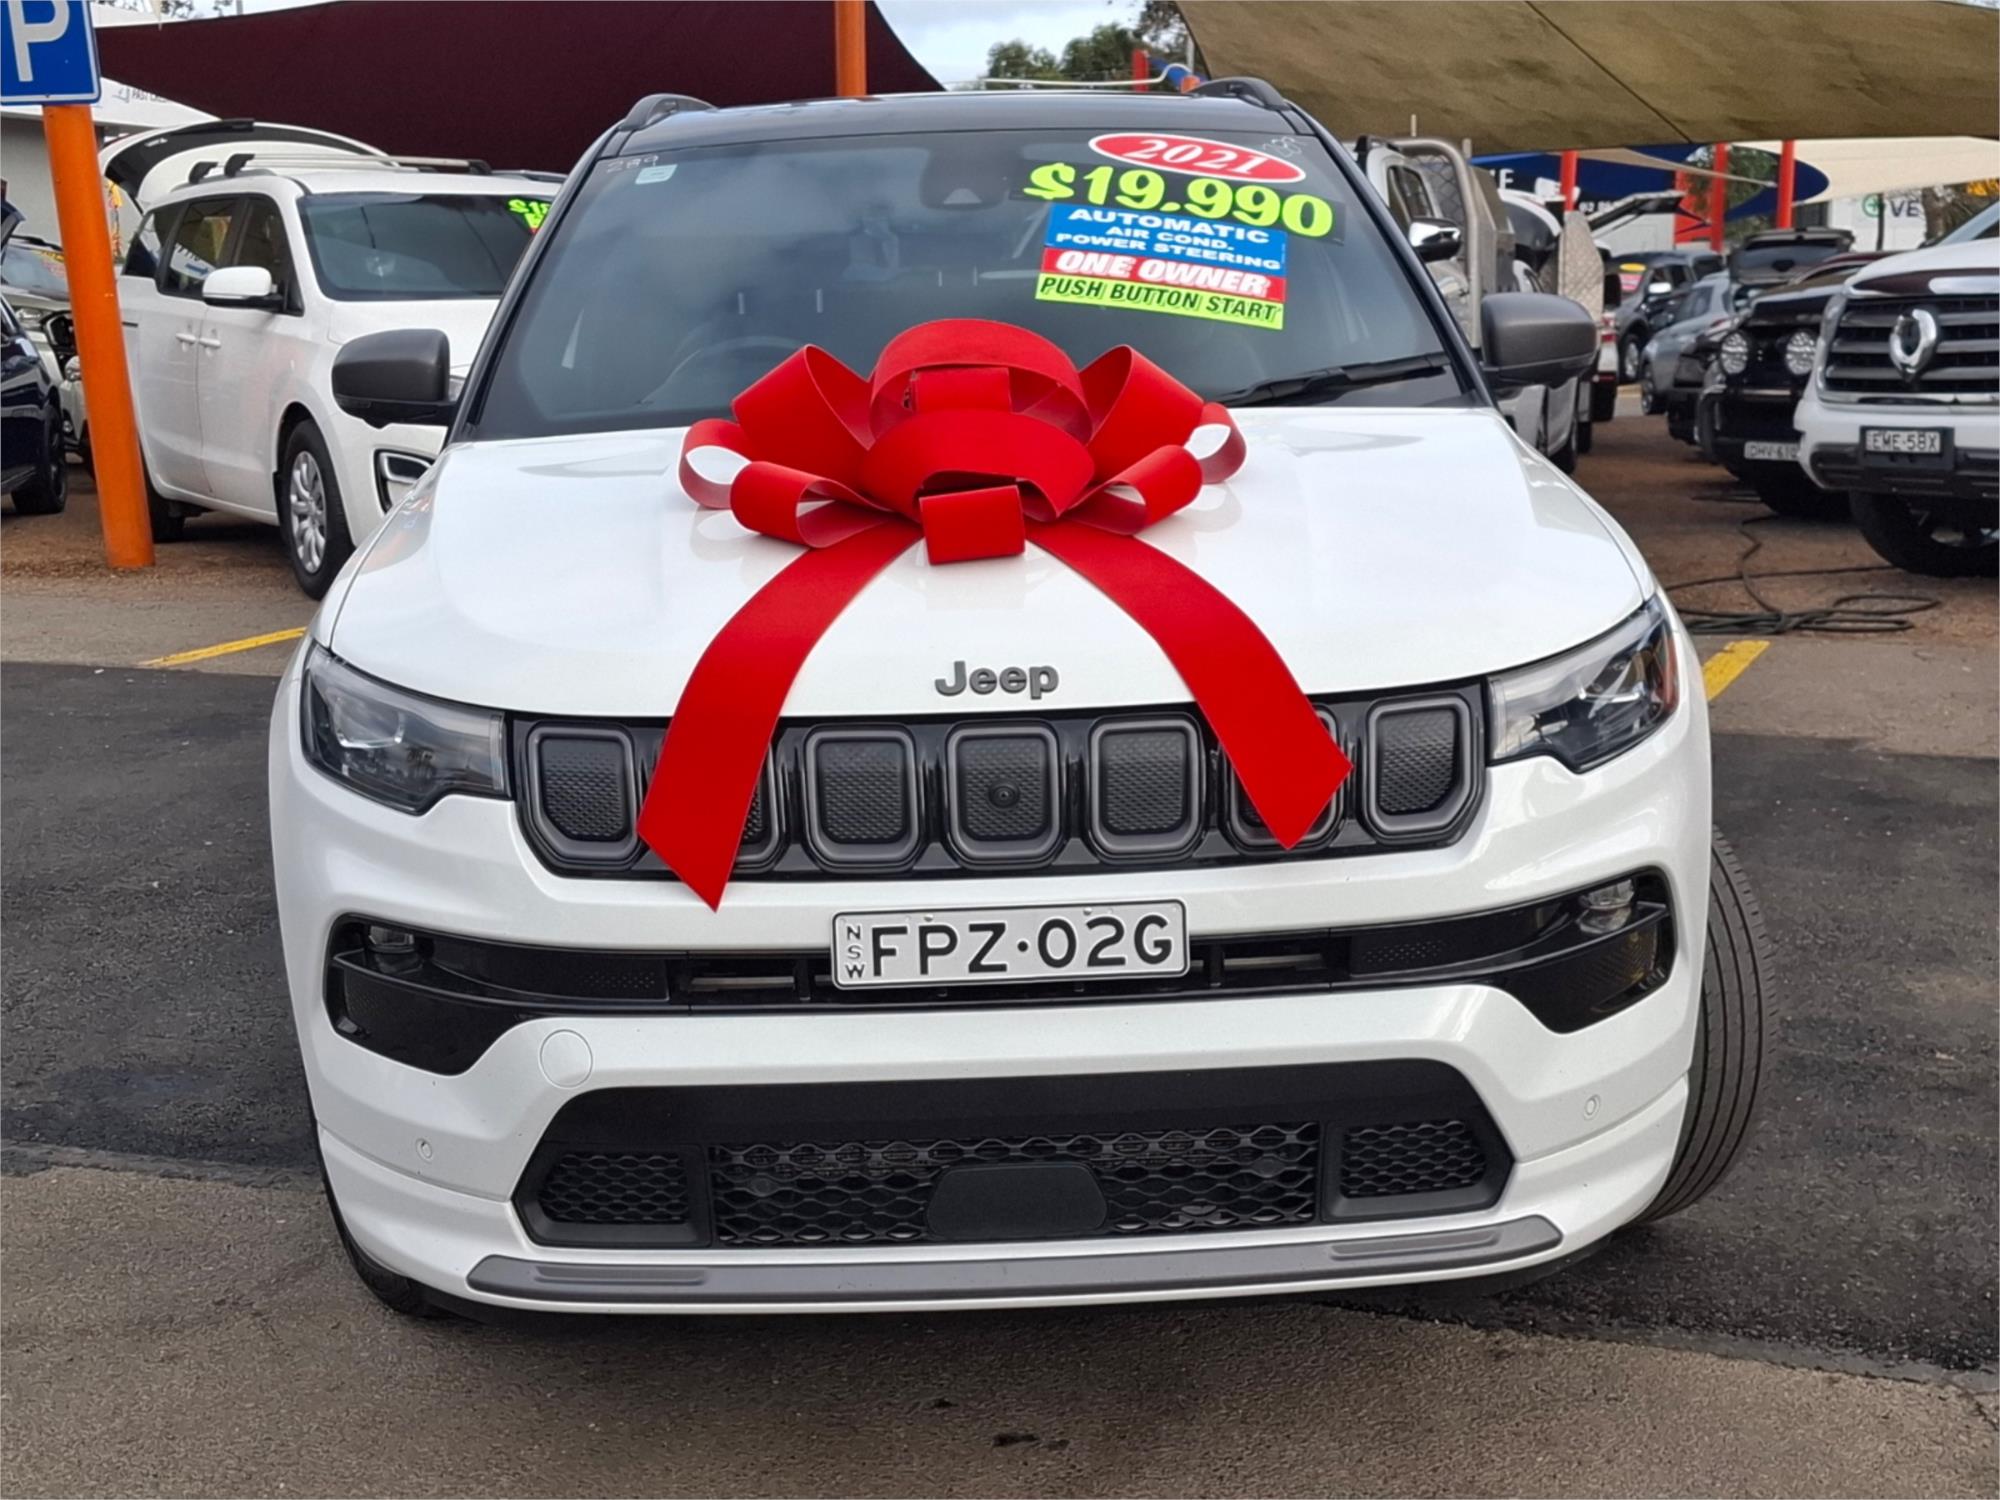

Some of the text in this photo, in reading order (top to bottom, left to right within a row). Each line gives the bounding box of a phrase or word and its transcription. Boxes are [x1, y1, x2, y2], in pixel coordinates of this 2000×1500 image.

[8, 0, 70, 82] P
[1125, 139, 1267, 175] 2021
[1068, 208, 1270, 244] AUTOMATIC
[1105, 226, 1234, 251] AIR COND.
[1056, 233, 1281, 271] POWER STEERING
[1055, 250, 1272, 296] ONE OWNER
[1040, 277, 1279, 323] PUSH BUTTON START
[935, 661, 1059, 700] Jeep
